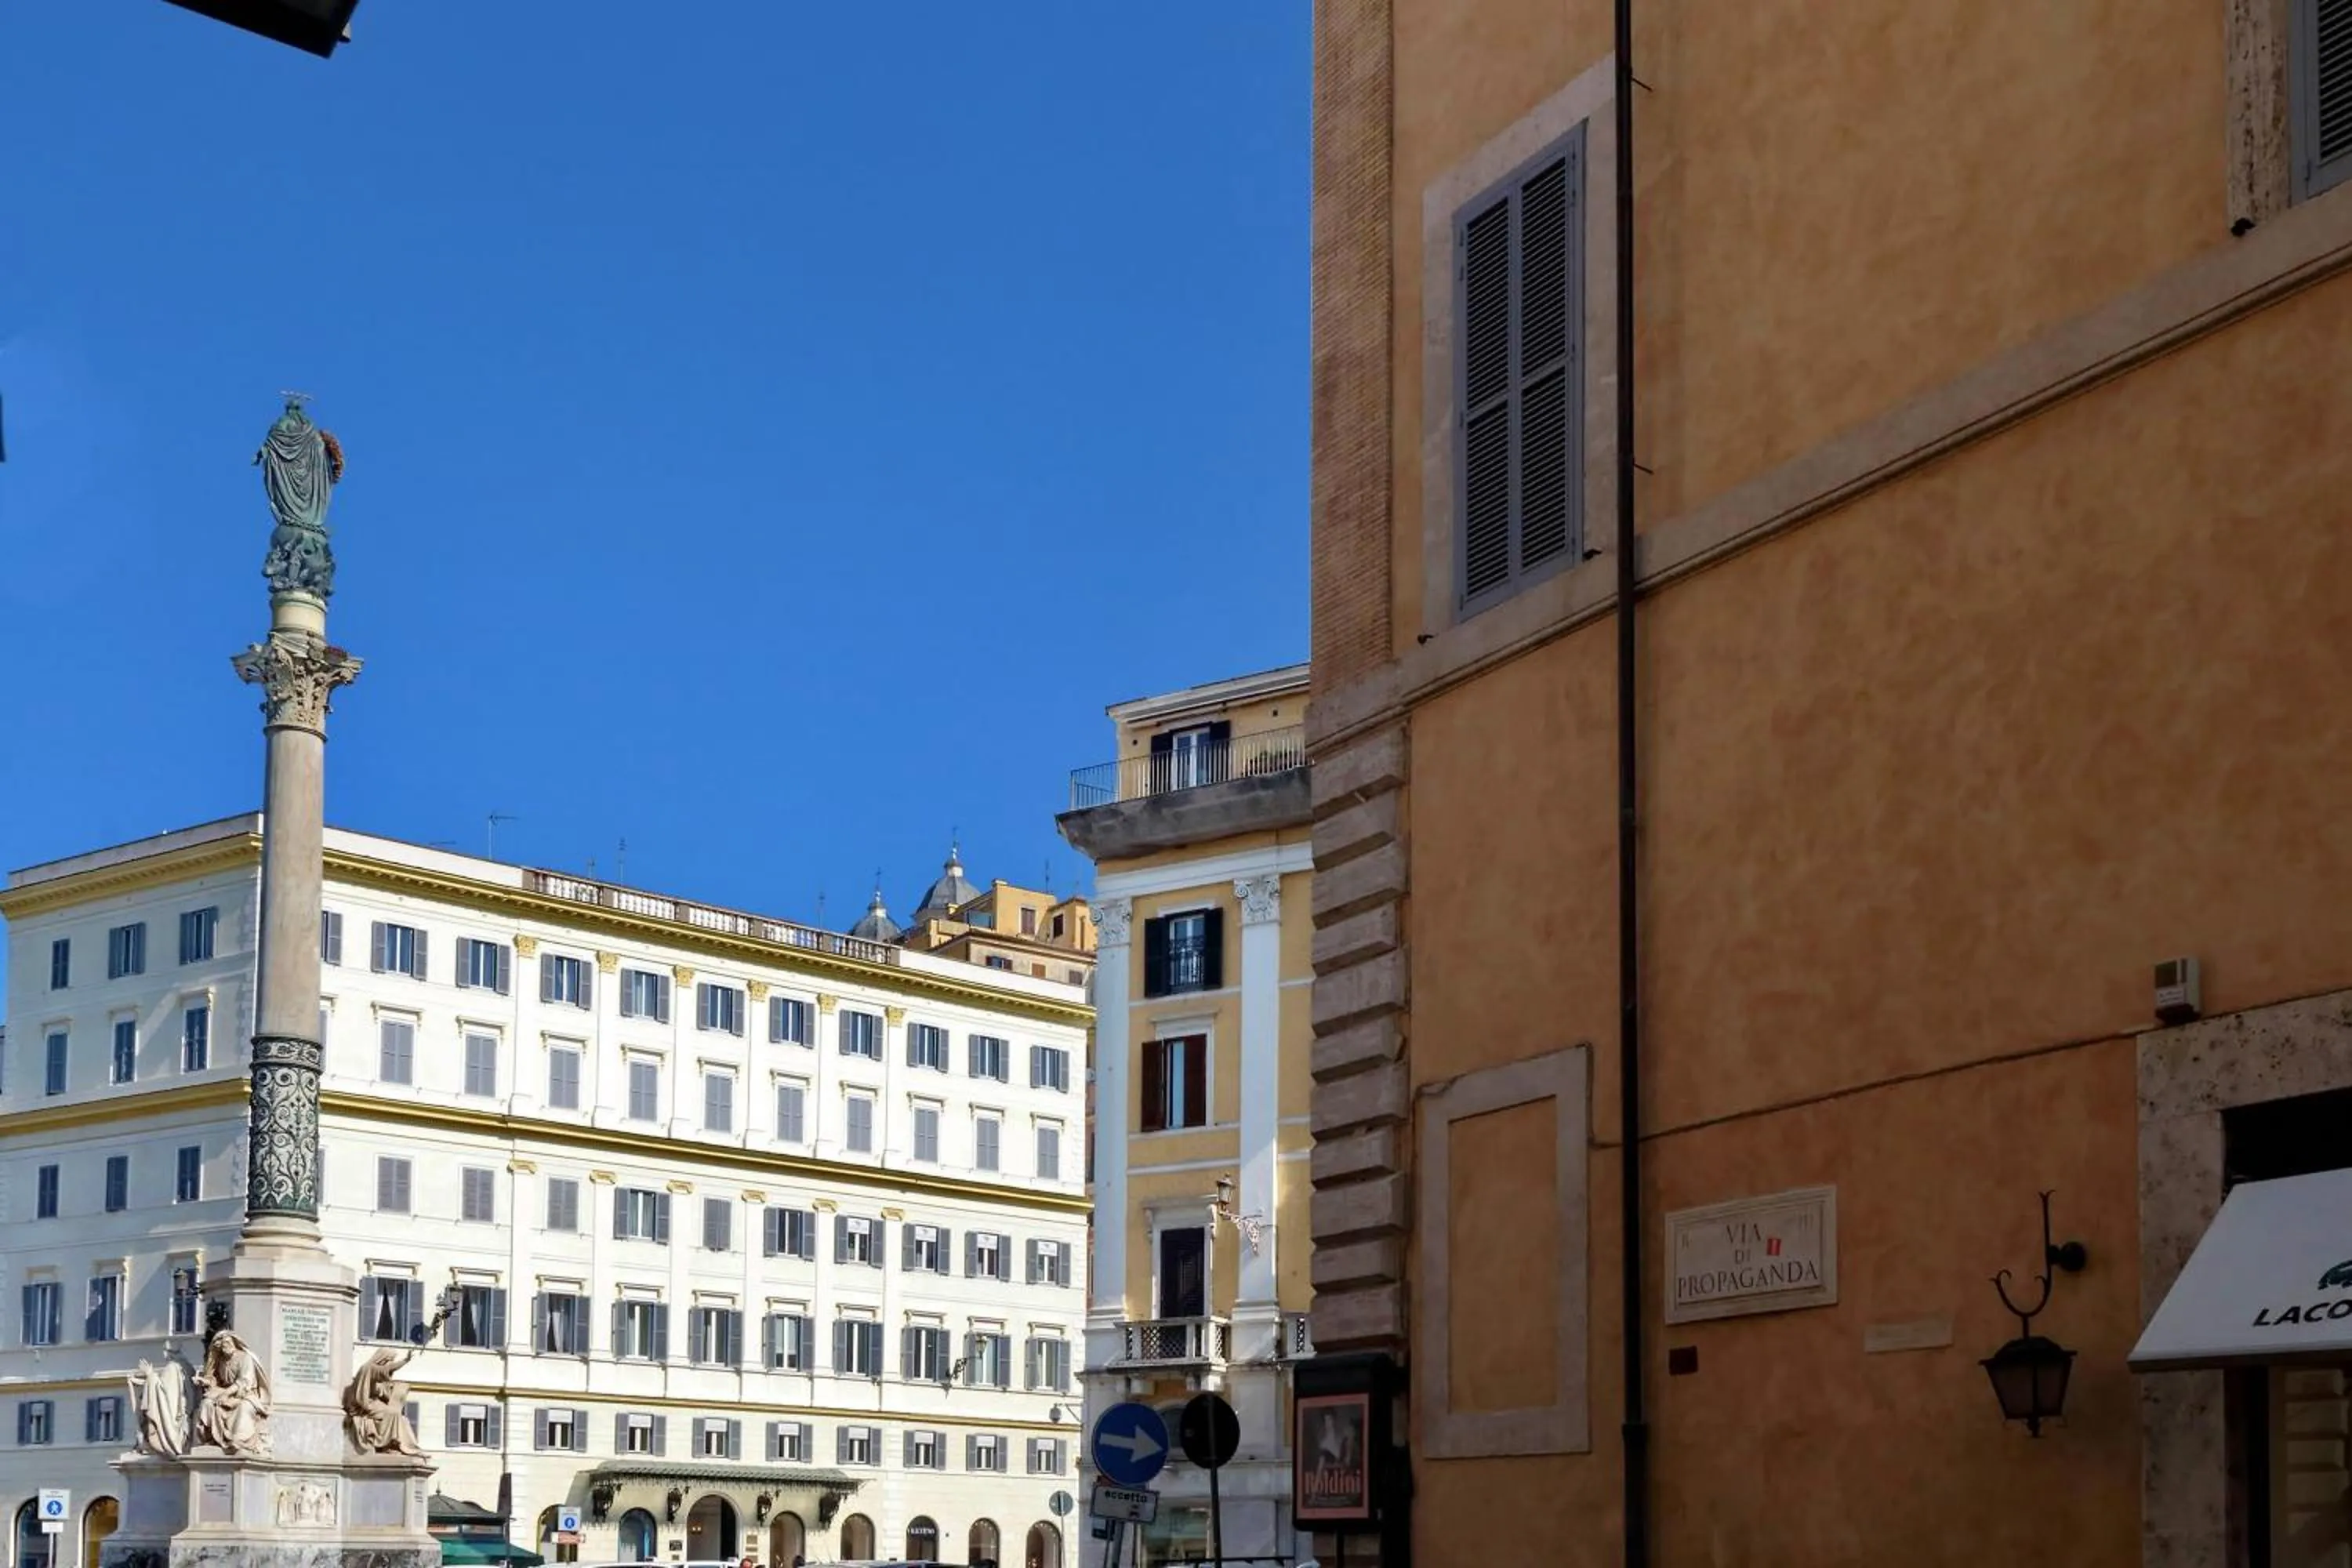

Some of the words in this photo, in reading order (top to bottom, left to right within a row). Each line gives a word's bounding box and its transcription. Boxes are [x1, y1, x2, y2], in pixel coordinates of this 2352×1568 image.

[1726, 1223, 1762, 1243] VIA
[1735, 1248, 1751, 1265] DI
[1678, 1259, 1818, 1298] PROPAGANDA
[2252, 1299, 2352, 1327] LACO
